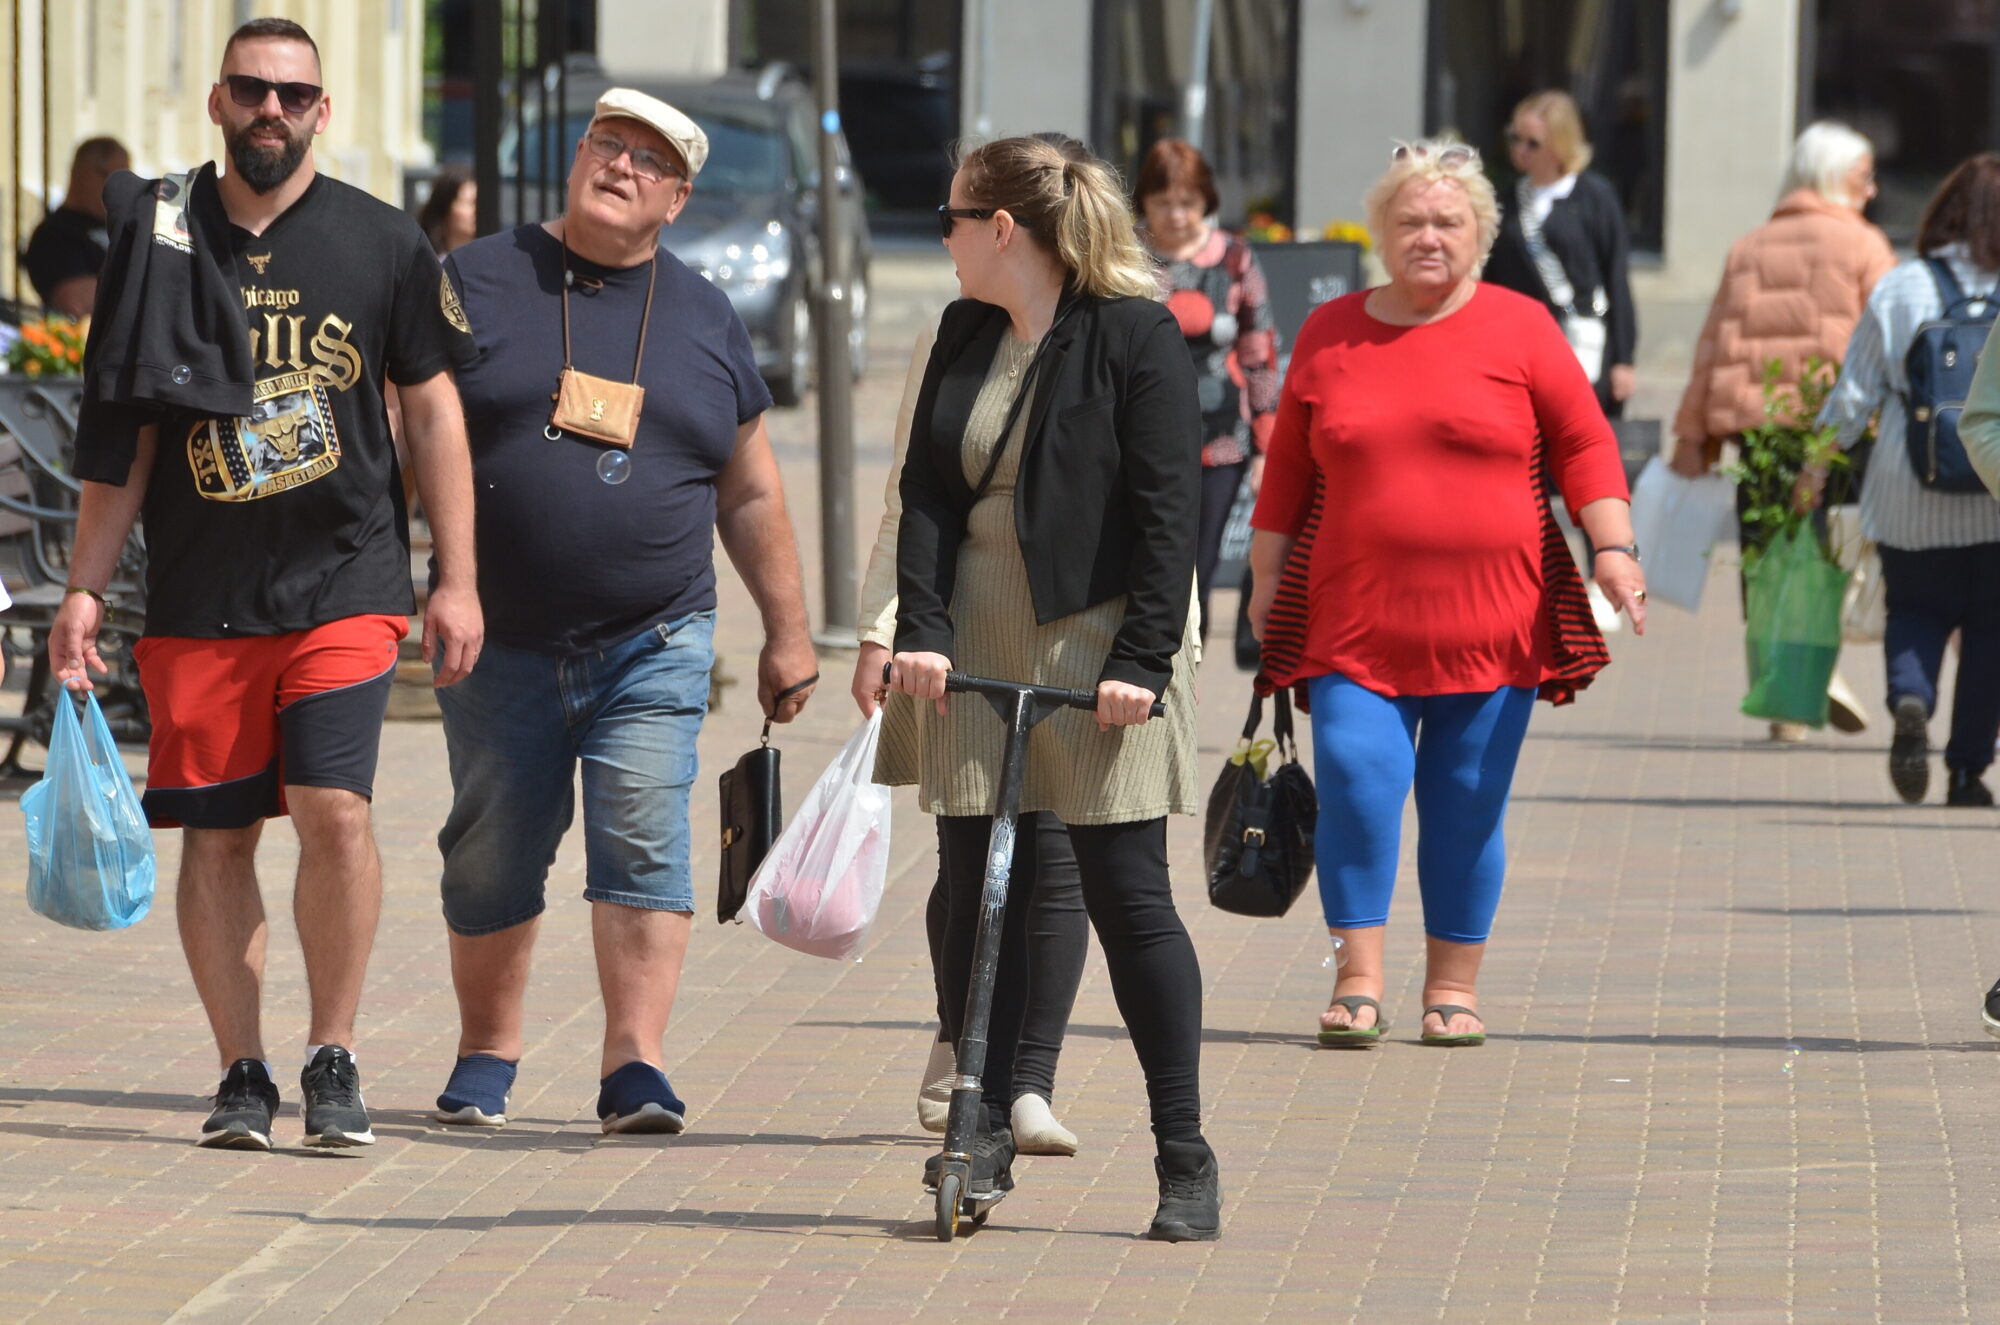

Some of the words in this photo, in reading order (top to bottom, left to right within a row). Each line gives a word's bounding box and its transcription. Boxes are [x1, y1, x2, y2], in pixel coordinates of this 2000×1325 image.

[241, 285, 300, 310] hicago
[276, 374, 309, 392] BULLS
[257, 456, 334, 495] BASKETBALL
